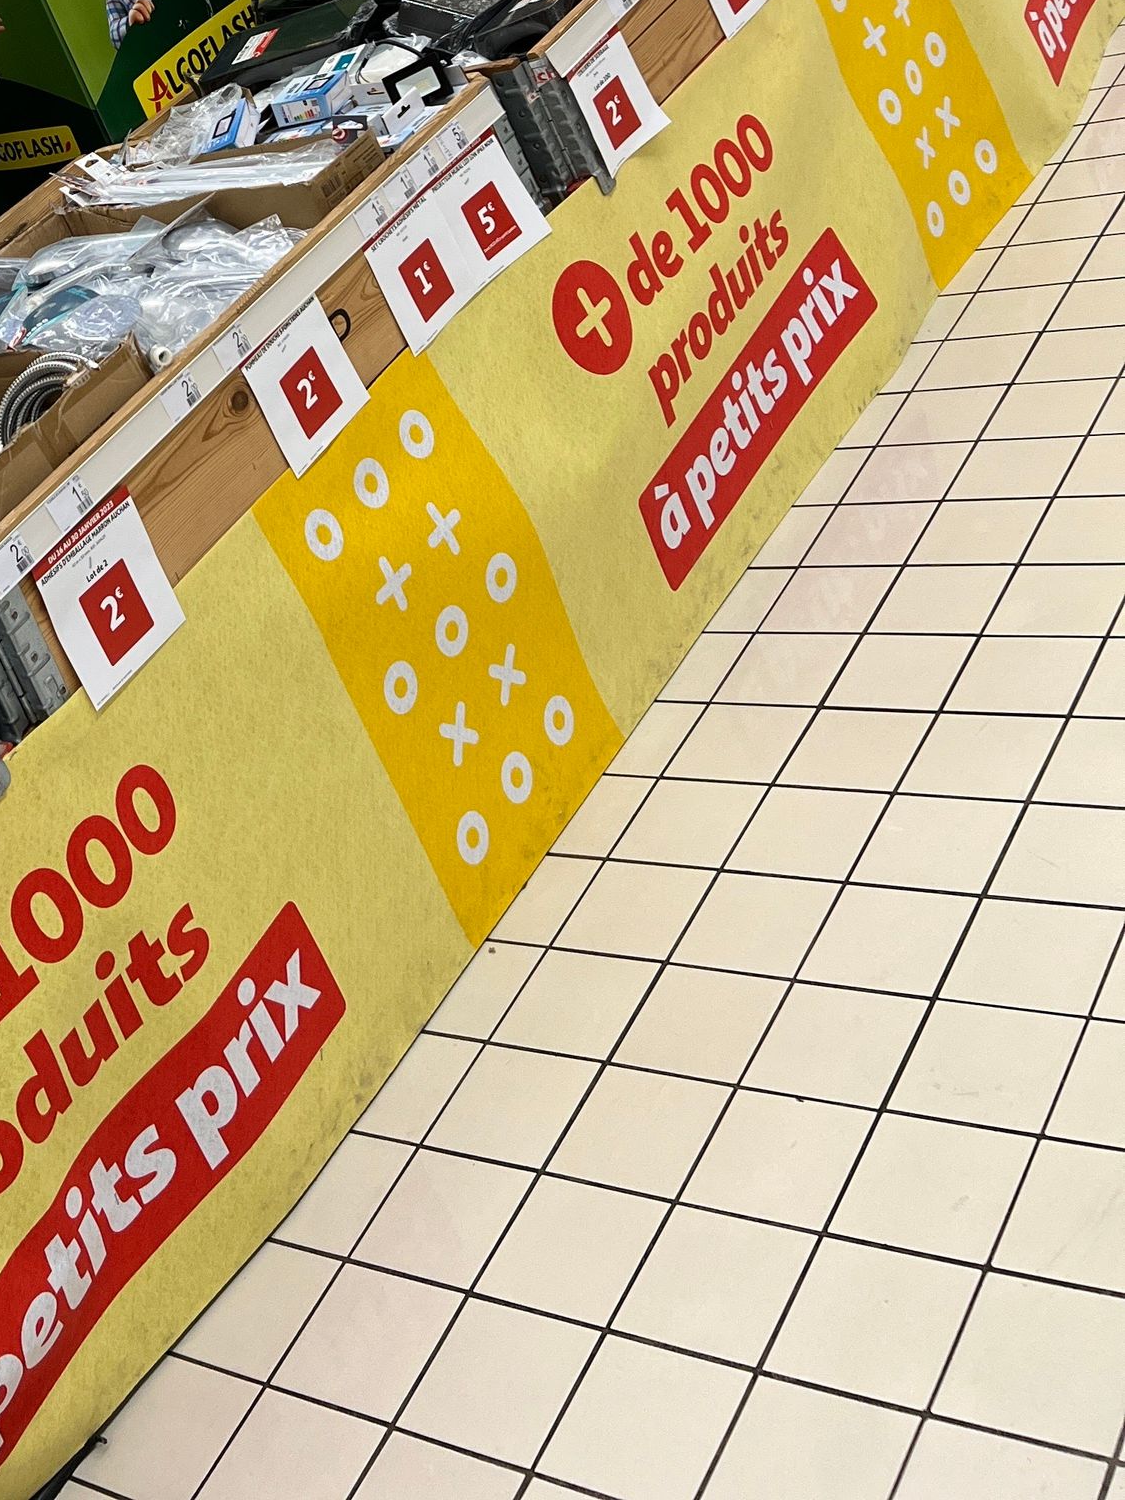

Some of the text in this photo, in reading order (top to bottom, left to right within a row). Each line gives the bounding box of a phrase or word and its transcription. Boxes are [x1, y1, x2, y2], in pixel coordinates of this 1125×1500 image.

[1029, 11, 1054, 59] à
[477, 201, 495, 235] 5€
[626, 114, 773, 306] de 1000
[414, 260, 432, 295] 1€
[647, 209, 789, 427] produits
[297, 370, 318, 410] 2€
[654, 258, 858, 549] à petits prix
[47, 500, 114, 564] DU 16 AU 30 JANVIER 2023
[62, 536, 92, 565] D'EMBALLAGE
[92, 518, 111, 538] MARRON
[111, 501, 130, 521] AUCHAN
[86, 571, 96, 582] Lot
[100, 586, 125, 632] 2€
[175, 947, 323, 1171] prix
